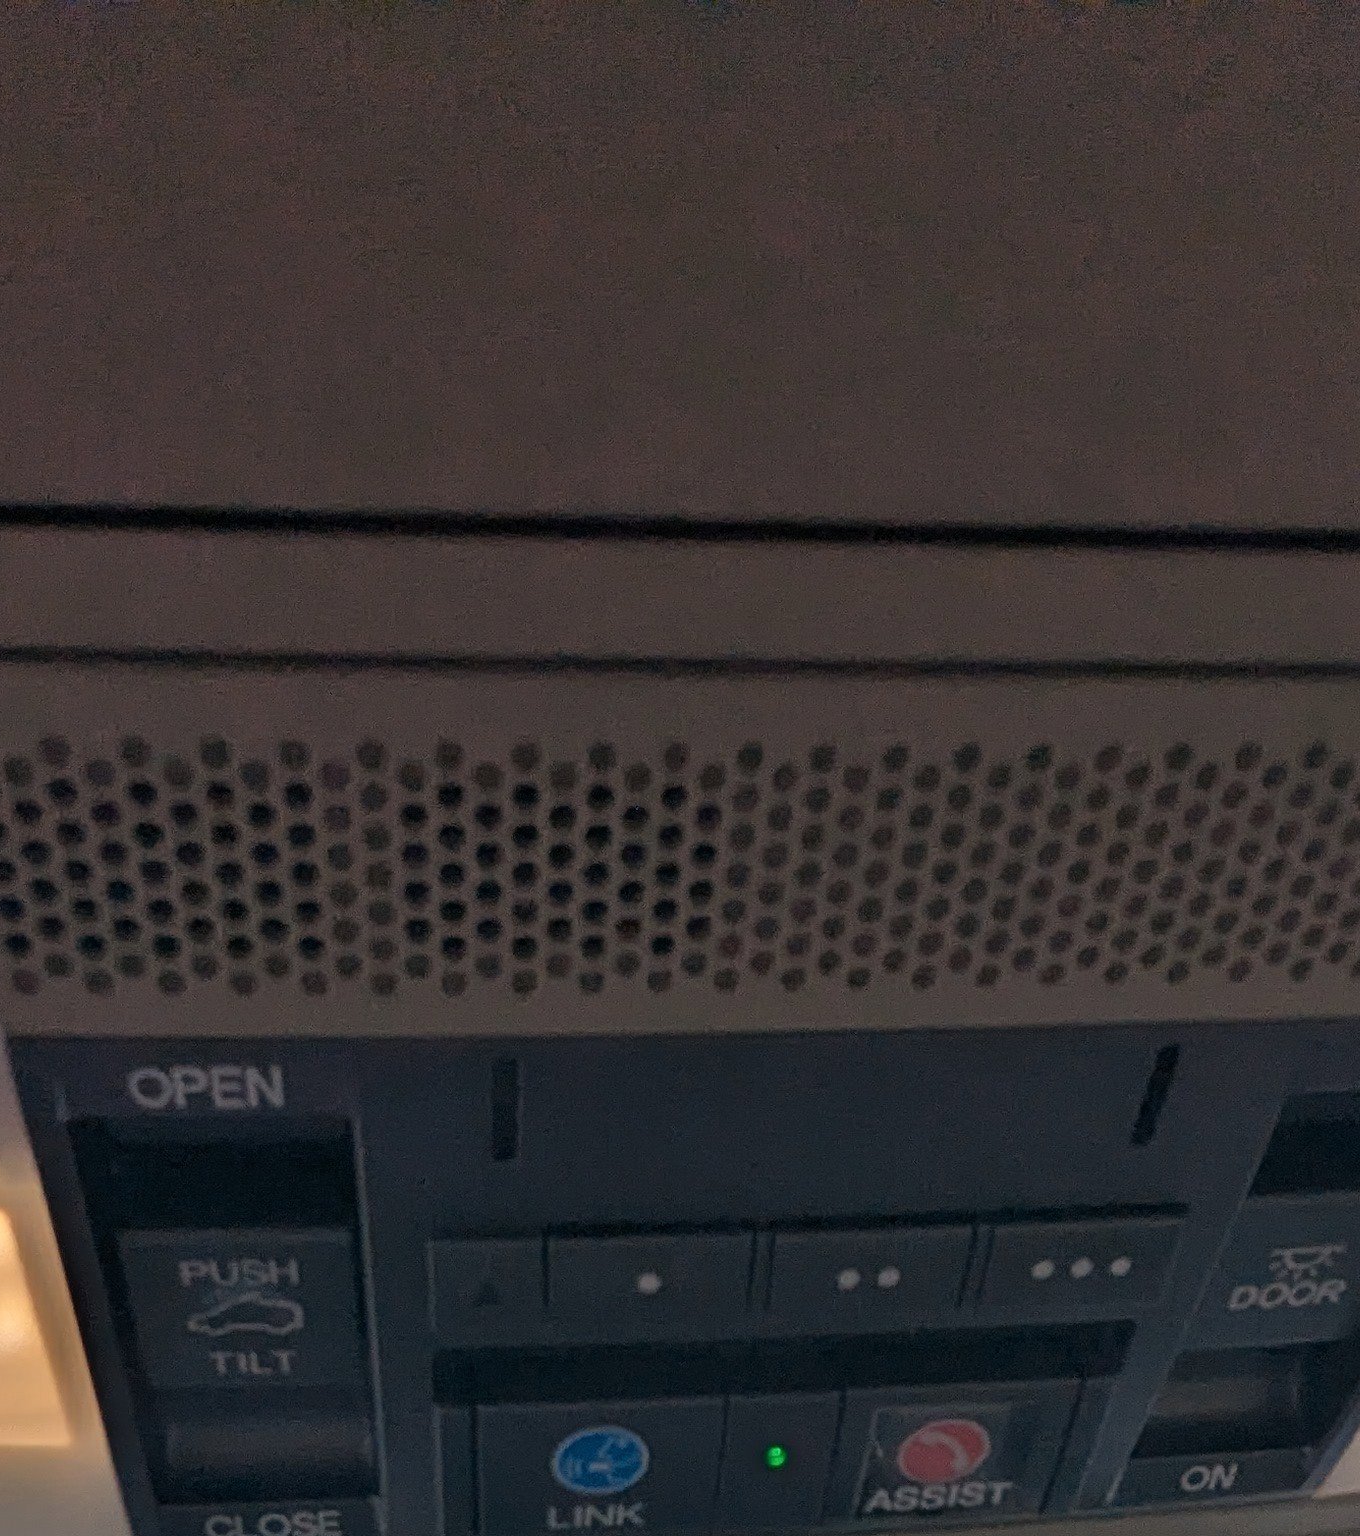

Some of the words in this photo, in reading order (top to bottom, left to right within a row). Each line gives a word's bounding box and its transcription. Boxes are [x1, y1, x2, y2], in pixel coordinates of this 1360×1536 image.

[127, 1066, 285, 1109] OPEN
[179, 1259, 300, 1287] PUSH
[1228, 1279, 1347, 1310] DOOR
[210, 1350, 298, 1376] TILT
[1180, 1464, 1238, 1491] ON
[864, 1481, 1013, 1513] ASSIST
[548, 1503, 643, 1529] LINK
